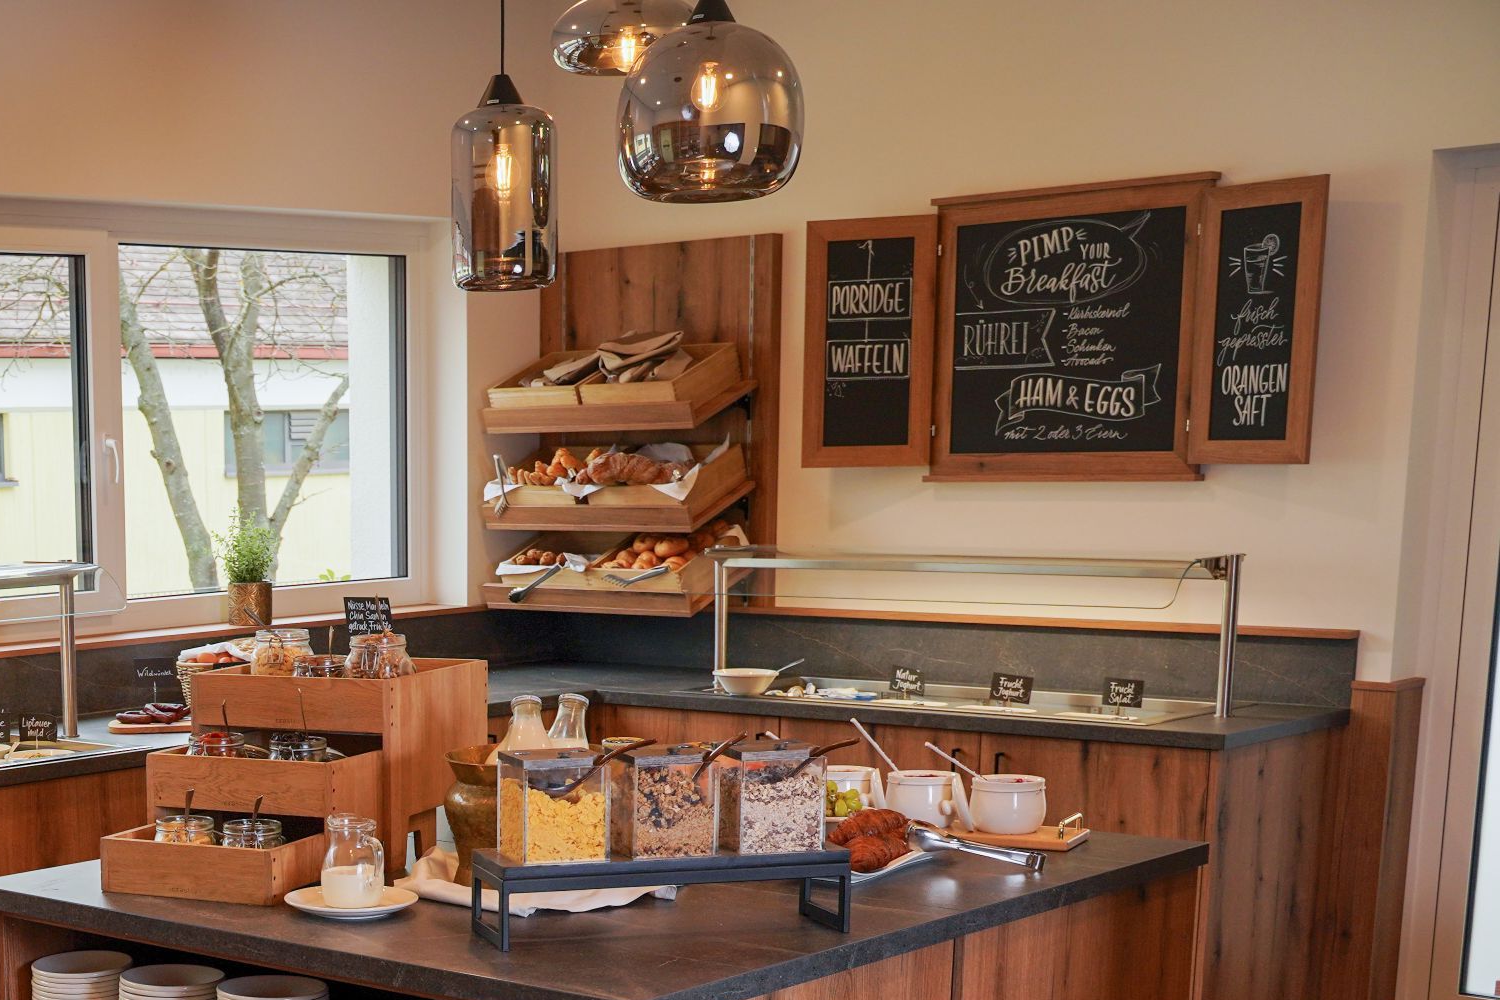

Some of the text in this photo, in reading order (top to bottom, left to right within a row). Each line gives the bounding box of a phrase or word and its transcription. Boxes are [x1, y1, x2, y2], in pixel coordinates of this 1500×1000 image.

[1018, 226, 1112, 266] PIMP YOUR
[1001, 257, 1122, 303] Breakfast
[832, 282, 906, 315] PORRIDGE
[1230, 297, 1279, 335] frisch
[963, 319, 1029, 356] RÜHREI
[1217, 325, 1288, 367] gepresster
[831, 343, 905, 374] WAFFELN
[1221, 362, 1288, 396] ORANGEN
[1015, 377, 1135, 417] HAM & EGGS
[1233, 394, 1272, 427] SAFT
[1004, 426, 1036, 440] mit
[1035, 425, 1047, 441] 2
[1071, 424, 1083, 440] 3
[892, 679, 921, 692] Joghurt
[896, 669, 918, 681] Natur
[999, 677, 1023, 689] Frucht
[1109, 681, 1135, 694] Frucht
[993, 687, 1025, 700] Joghurt
[1108, 693, 1133, 704] Salat
[27, 728, 44, 738] mild
